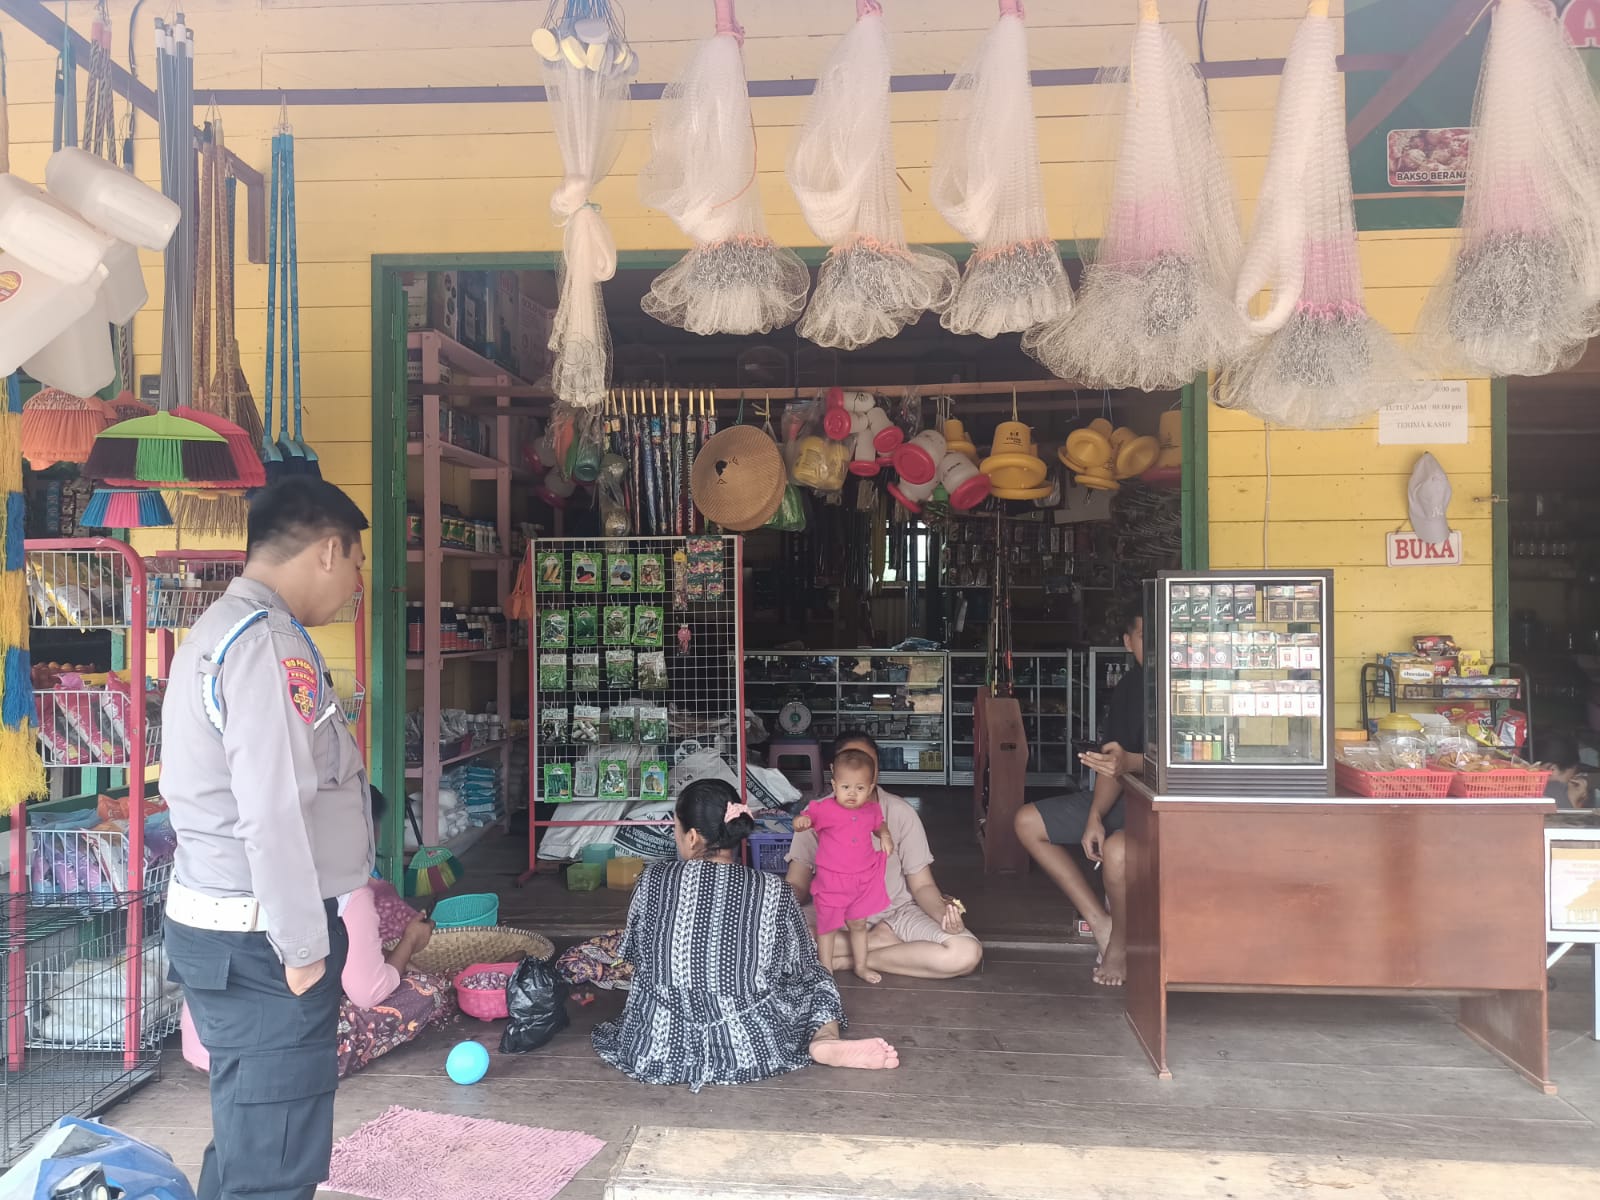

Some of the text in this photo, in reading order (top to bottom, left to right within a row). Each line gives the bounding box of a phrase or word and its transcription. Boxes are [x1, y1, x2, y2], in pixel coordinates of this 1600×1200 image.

[1397, 172, 1428, 181] BAKSO
[1396, 421, 1425, 429] TERIMA
[1395, 538, 1454, 559] BUKA
